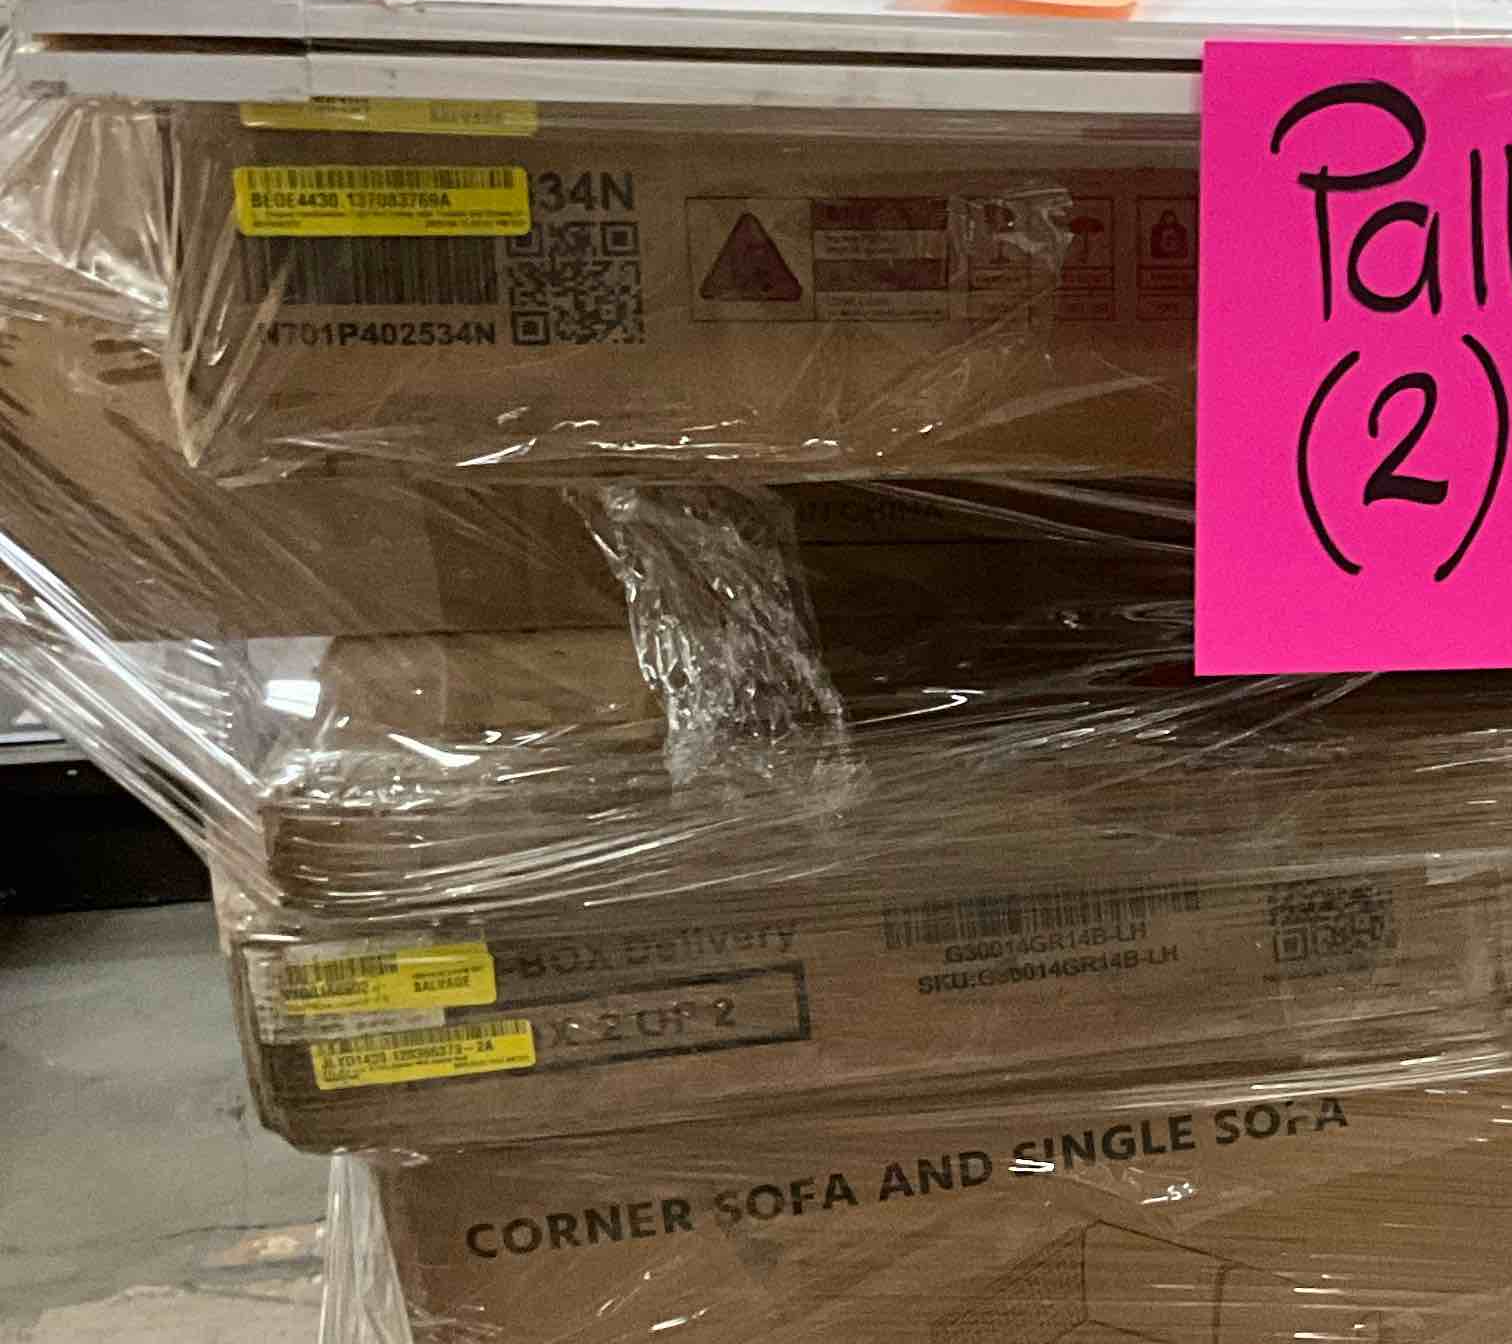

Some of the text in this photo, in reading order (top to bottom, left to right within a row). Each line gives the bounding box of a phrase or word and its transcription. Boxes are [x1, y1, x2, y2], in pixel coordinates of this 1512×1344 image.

[1295, 333, 1511, 583] (2)
[466, 1198, 694, 1261] CORNER
[715, 1171, 859, 1233] SOFA
[878, 1150, 994, 1203] AND
[1007, 1113, 1196, 1178] SINGLE
